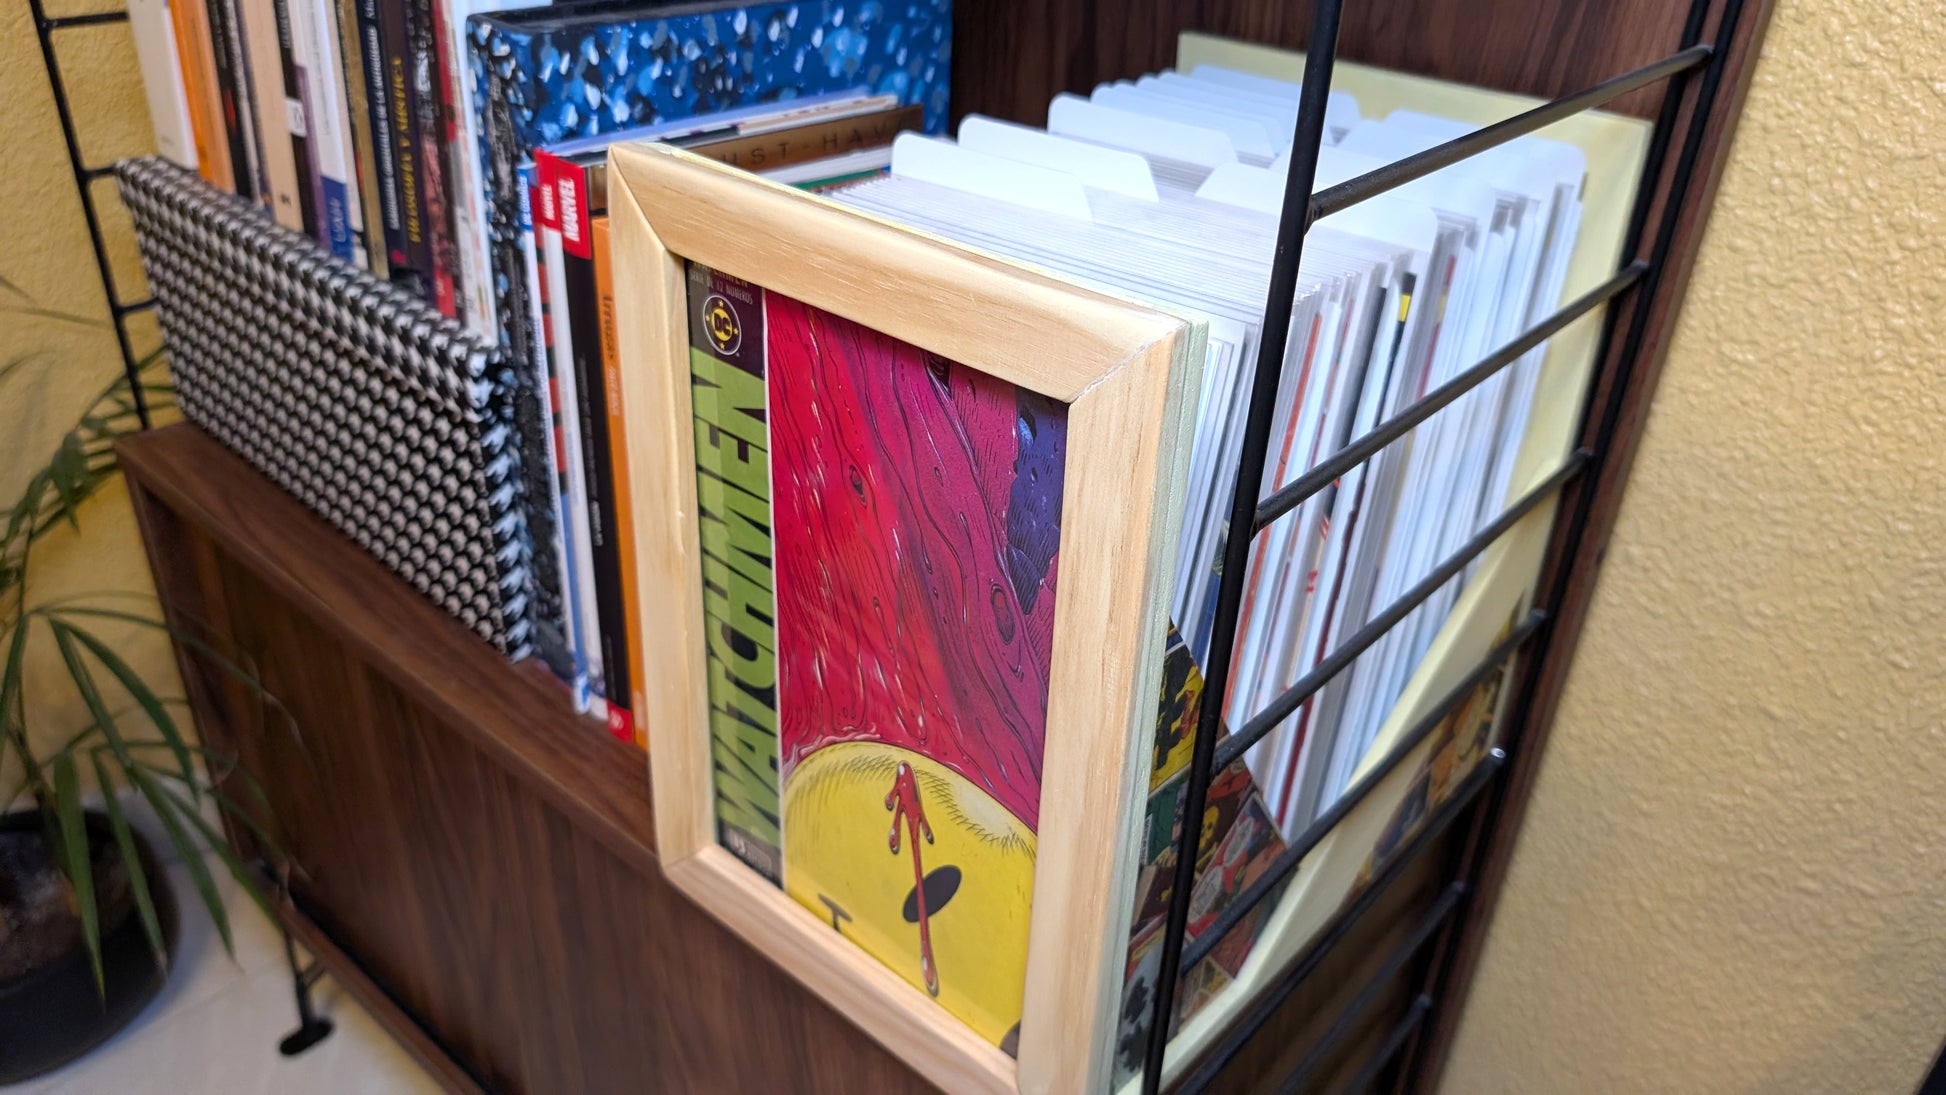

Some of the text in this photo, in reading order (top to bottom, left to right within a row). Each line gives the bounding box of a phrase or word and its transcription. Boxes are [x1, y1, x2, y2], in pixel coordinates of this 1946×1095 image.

[557, 178, 580, 242] MARVEL
[713, 311, 731, 336] DC
[691, 347, 780, 848] WATCHMEN
